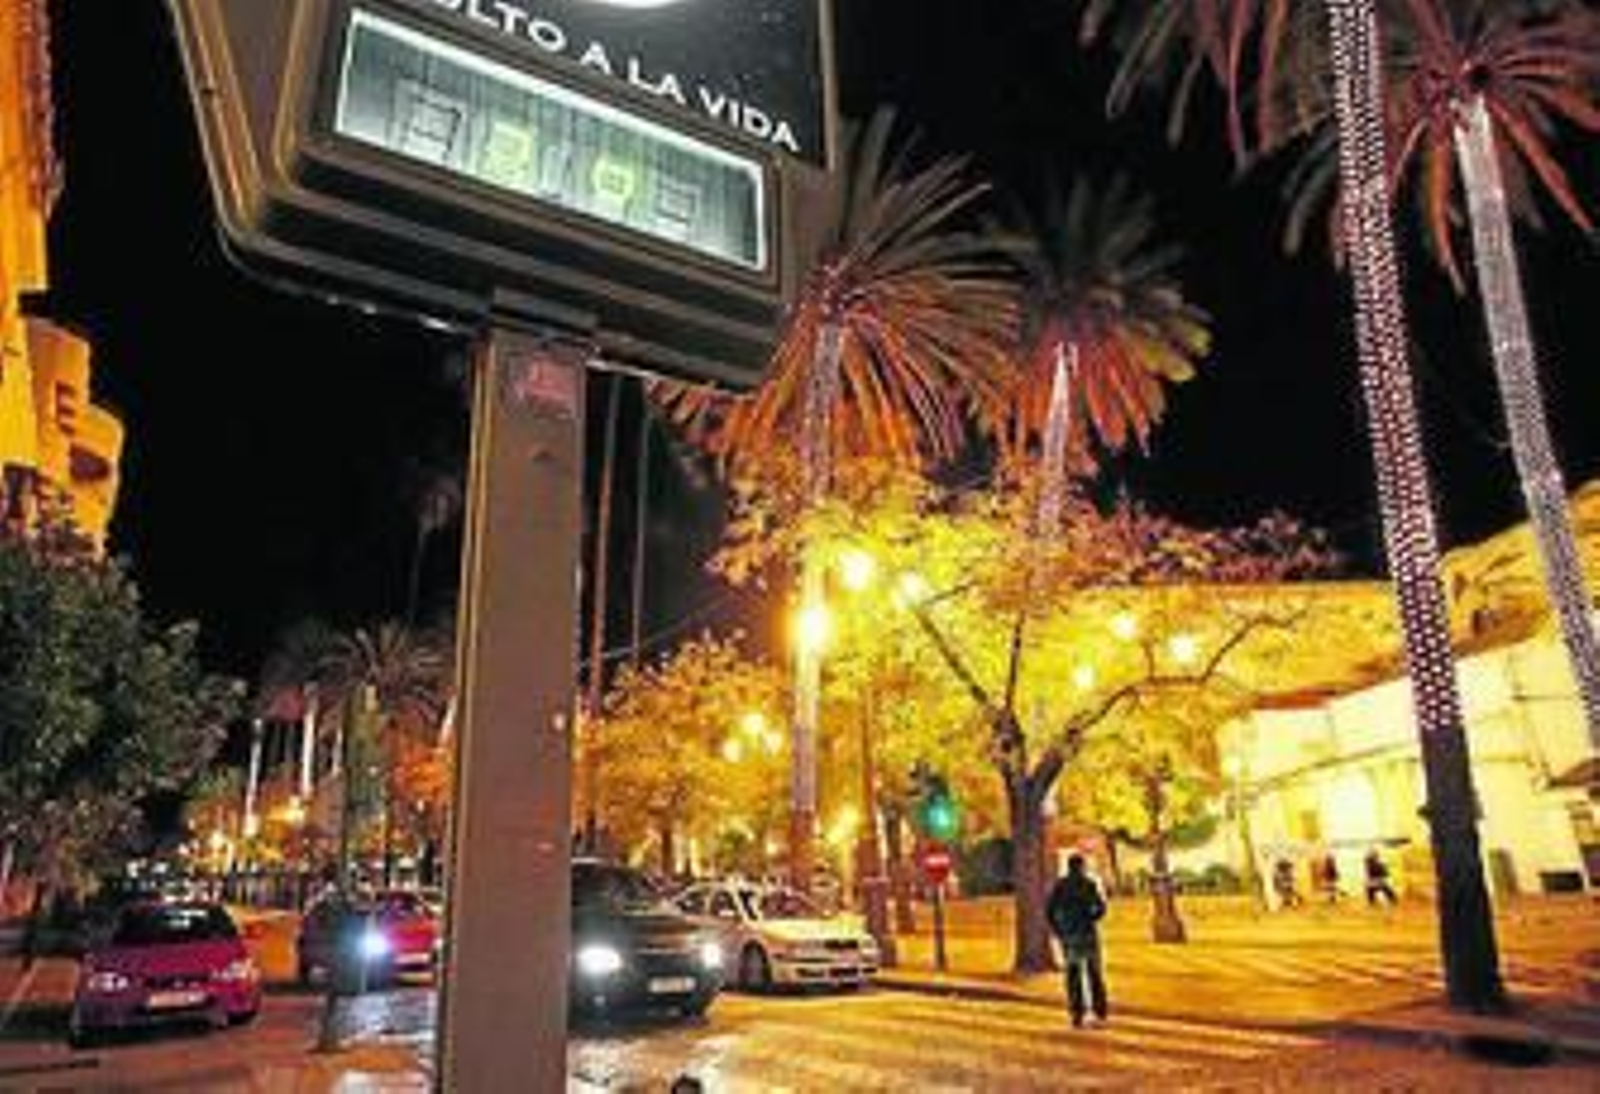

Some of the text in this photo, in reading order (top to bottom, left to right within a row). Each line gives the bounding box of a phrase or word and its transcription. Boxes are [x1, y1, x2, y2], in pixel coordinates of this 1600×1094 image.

[580, 42, 611, 75] A
[628, 58, 686, 105] LA
[699, 86, 799, 152] VIDA
